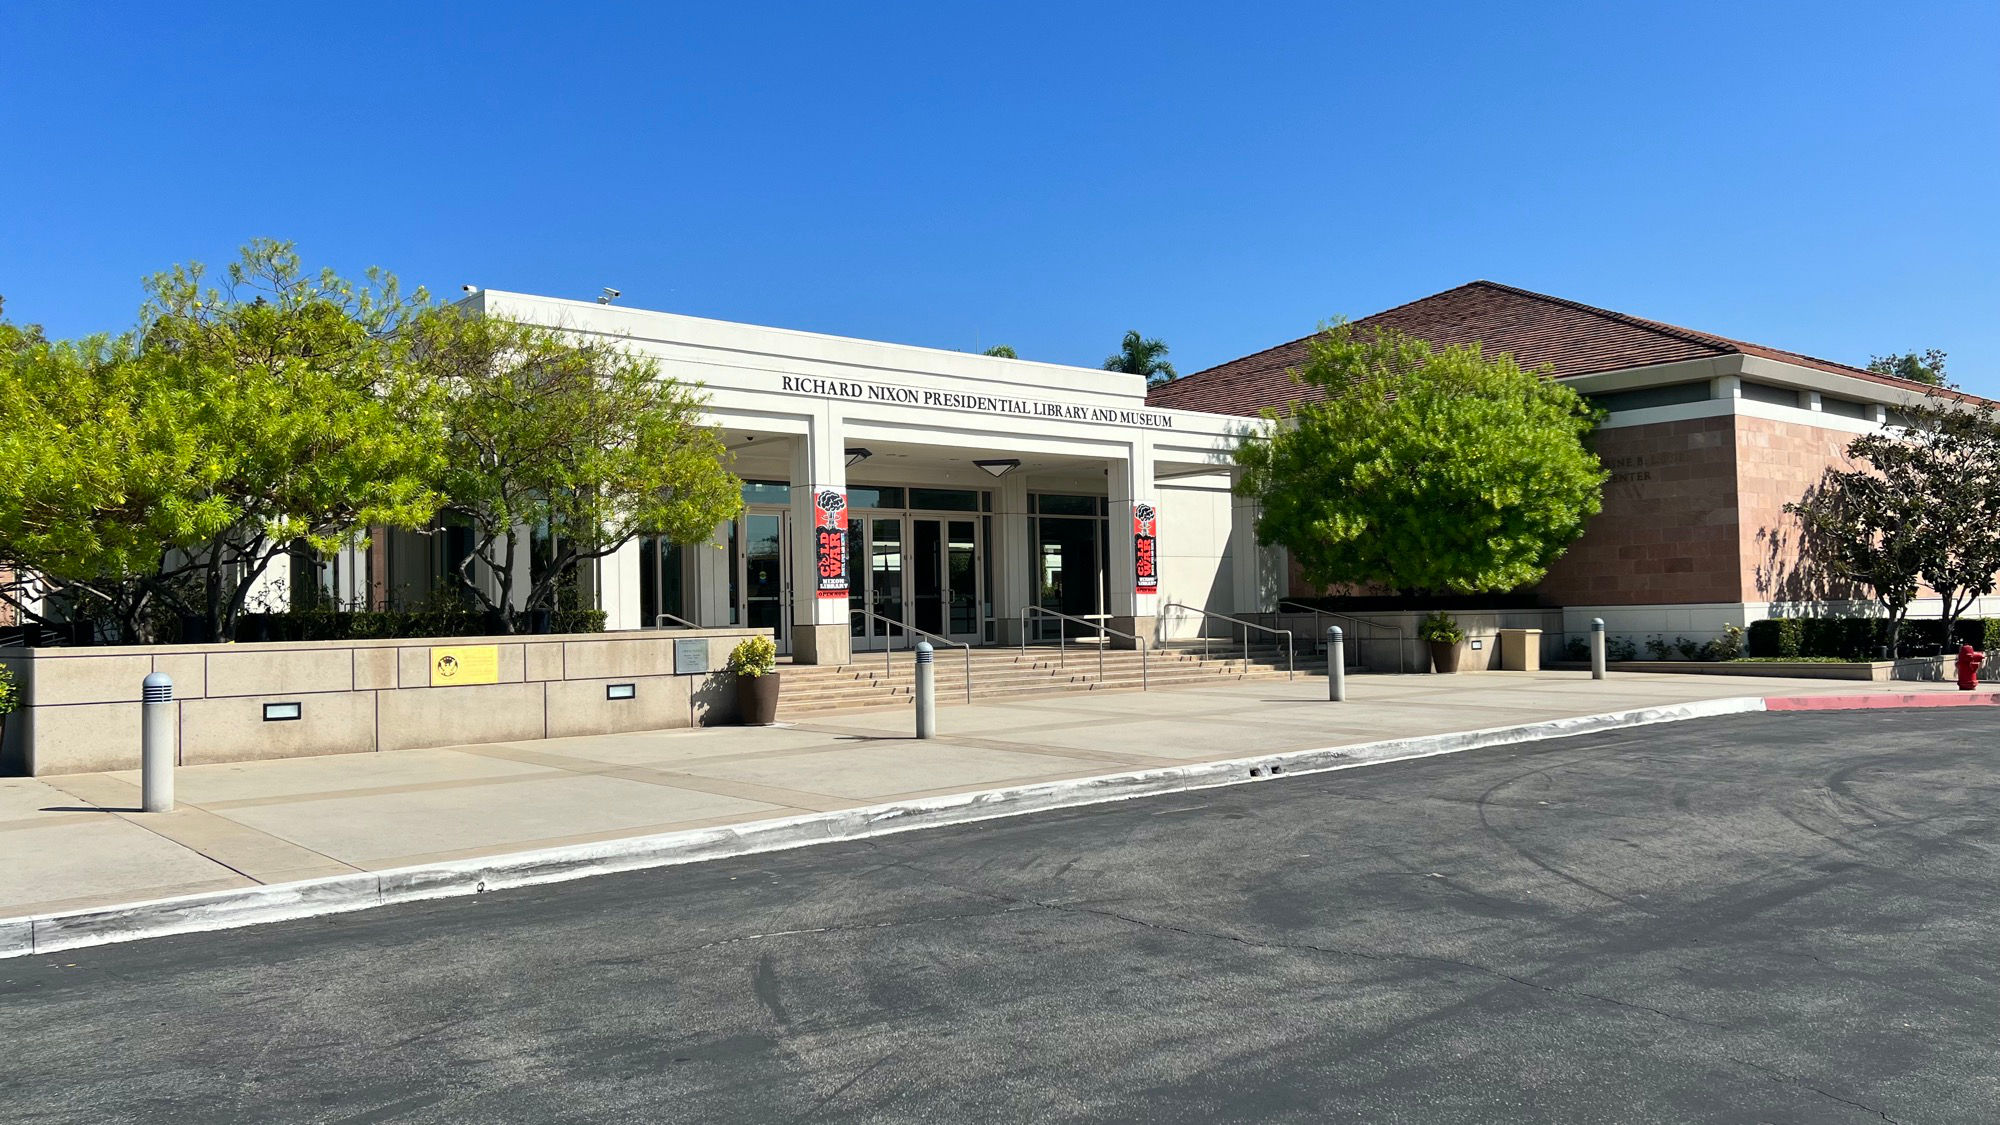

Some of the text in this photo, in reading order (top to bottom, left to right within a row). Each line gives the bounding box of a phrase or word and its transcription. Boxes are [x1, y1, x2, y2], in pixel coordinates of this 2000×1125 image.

[782, 375, 1173, 428] RICHARD NIXON PRESIDENTIAL LIBRARY AND MUSEUM
[830, 532, 841, 578] WAR
